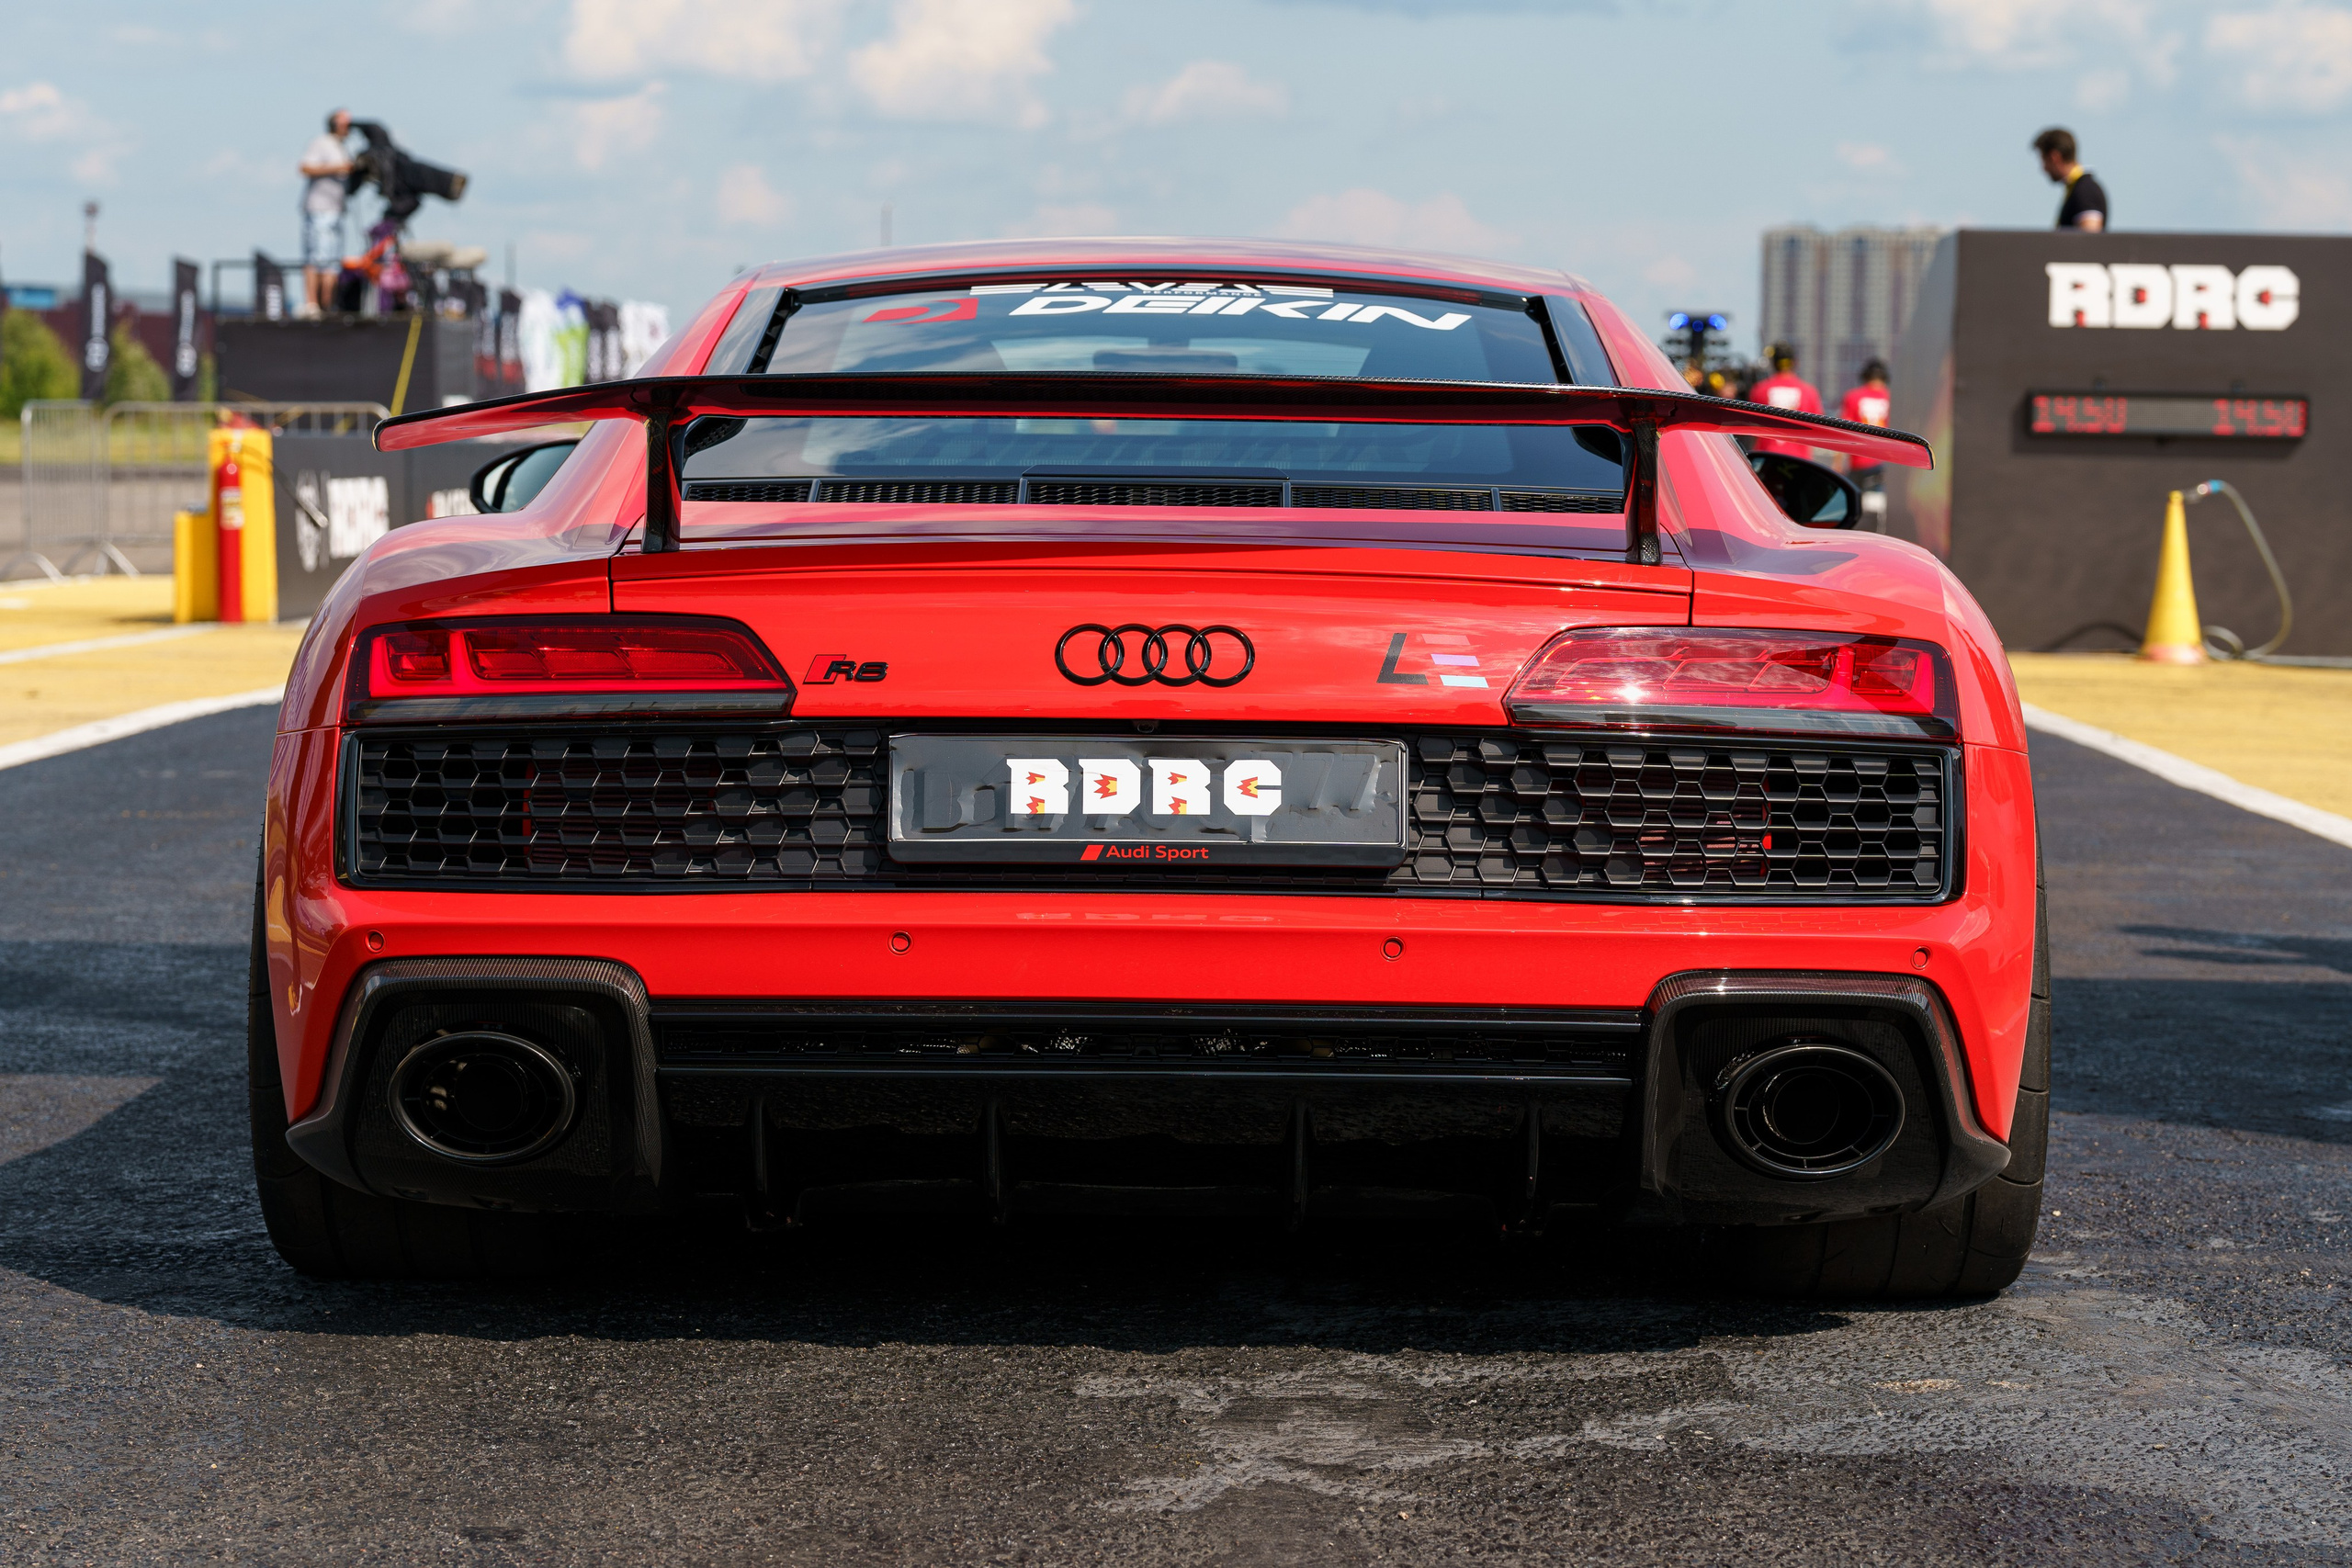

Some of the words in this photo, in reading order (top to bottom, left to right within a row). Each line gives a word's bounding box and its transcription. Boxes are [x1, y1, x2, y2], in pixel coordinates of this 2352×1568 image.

[2045, 263, 2301, 331] RDRC
[823, 660, 888, 682] R8
[1006, 758, 1283, 815] RDRC
[1105, 845, 1149, 858] Audi
[1155, 845, 1209, 862] Sport
